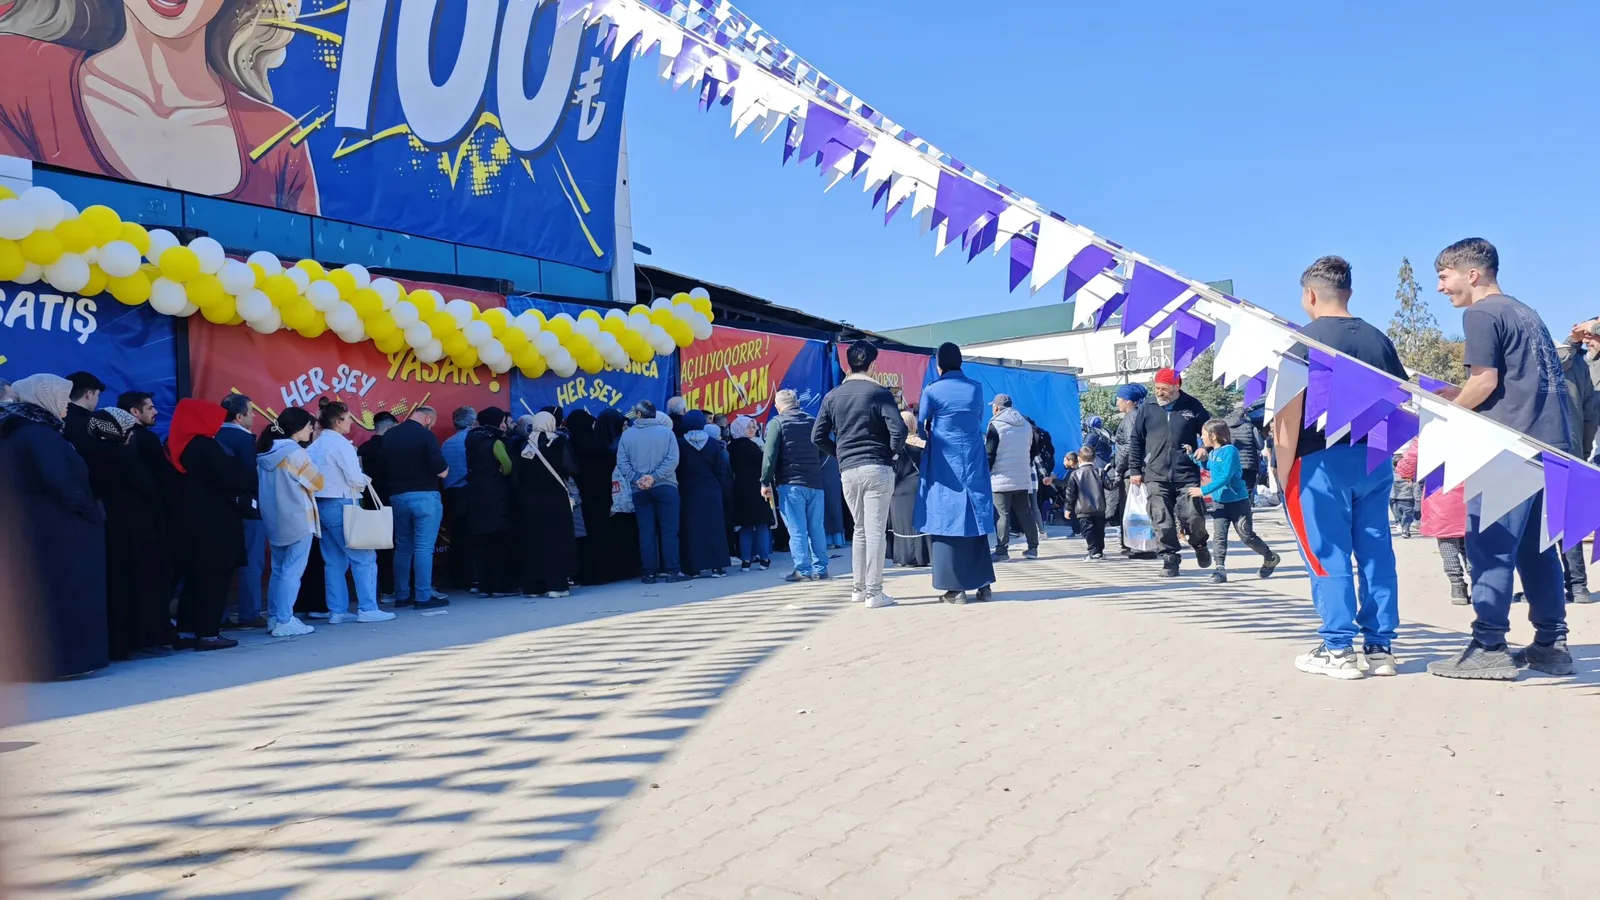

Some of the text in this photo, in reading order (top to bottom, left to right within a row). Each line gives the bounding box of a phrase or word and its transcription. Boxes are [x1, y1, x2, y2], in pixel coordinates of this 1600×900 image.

[765, 335, 770, 356] !
[280, 364, 377, 407] HER ŞEY
[557, 377, 623, 407] HER ŞEY
